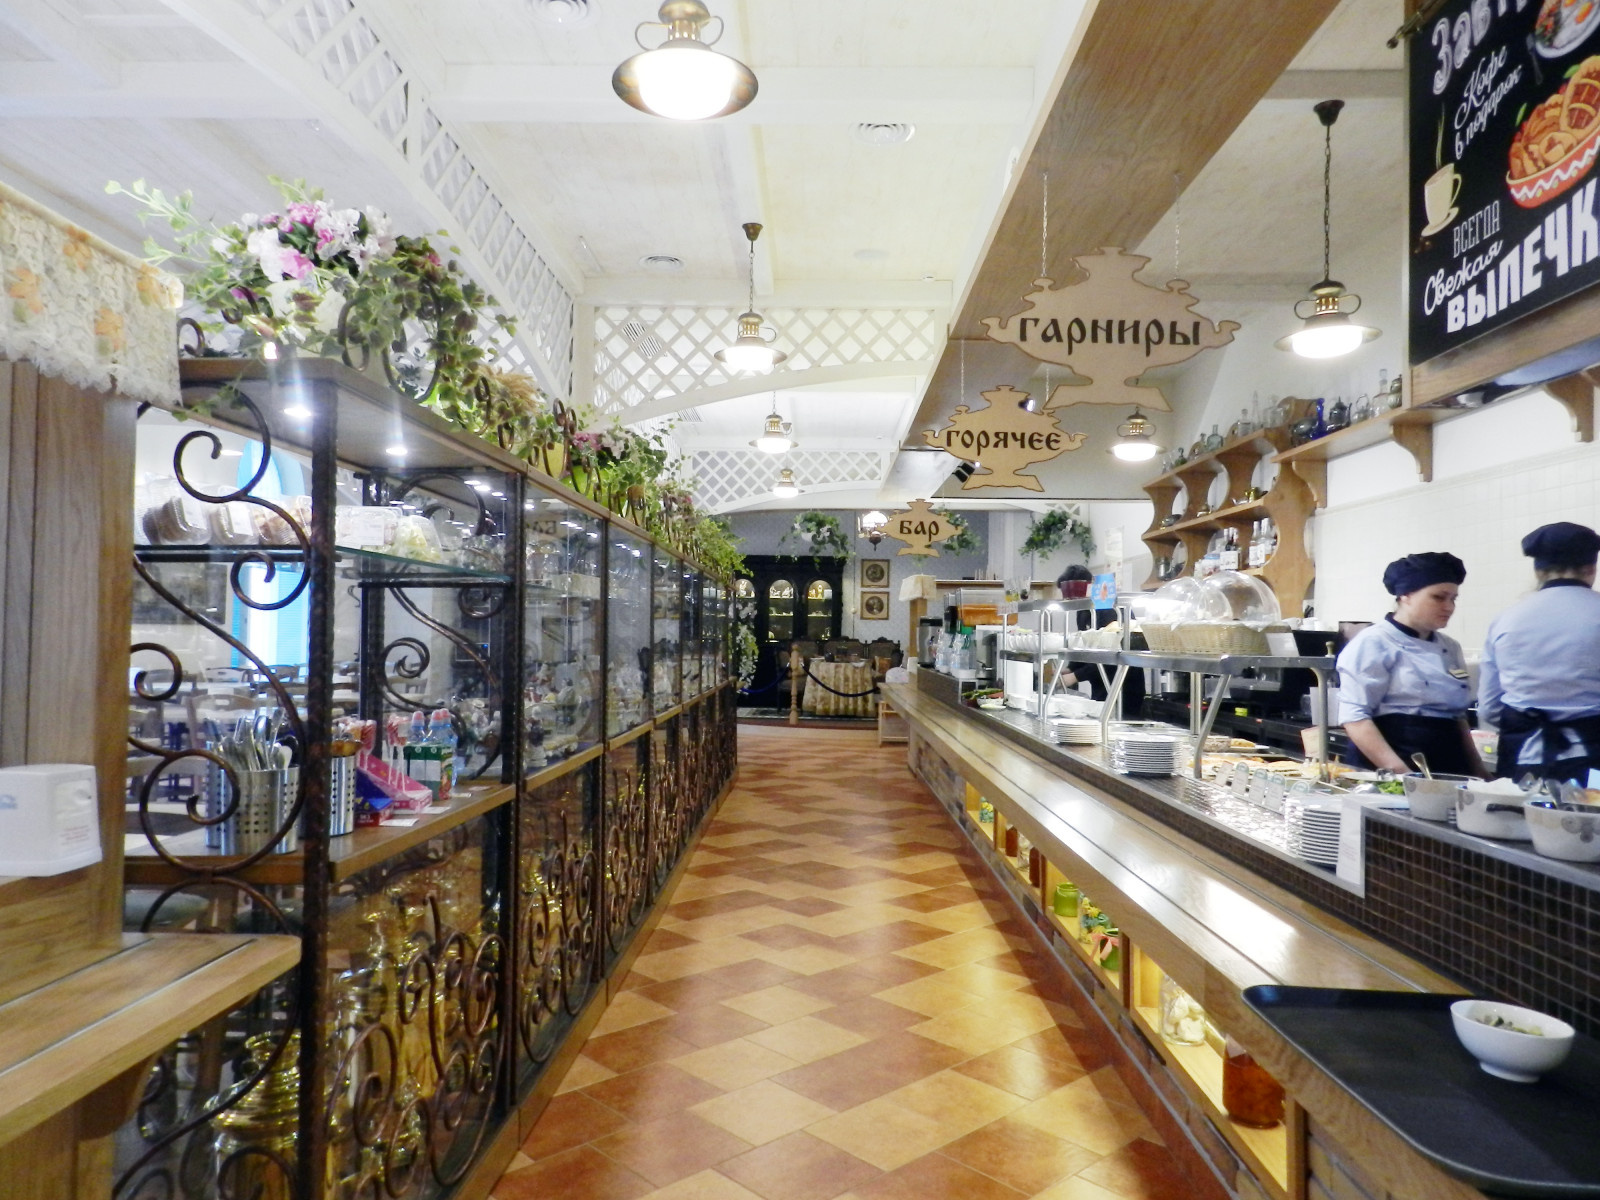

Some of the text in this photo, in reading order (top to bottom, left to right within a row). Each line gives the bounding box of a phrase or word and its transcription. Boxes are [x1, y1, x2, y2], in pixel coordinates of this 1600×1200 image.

[1454, 46, 1508, 130] Кофе
[1466, 65, 1524, 145] подарок
[1453, 200, 1501, 258] ВСЕГДА
[1424, 240, 1503, 316] Свежая
